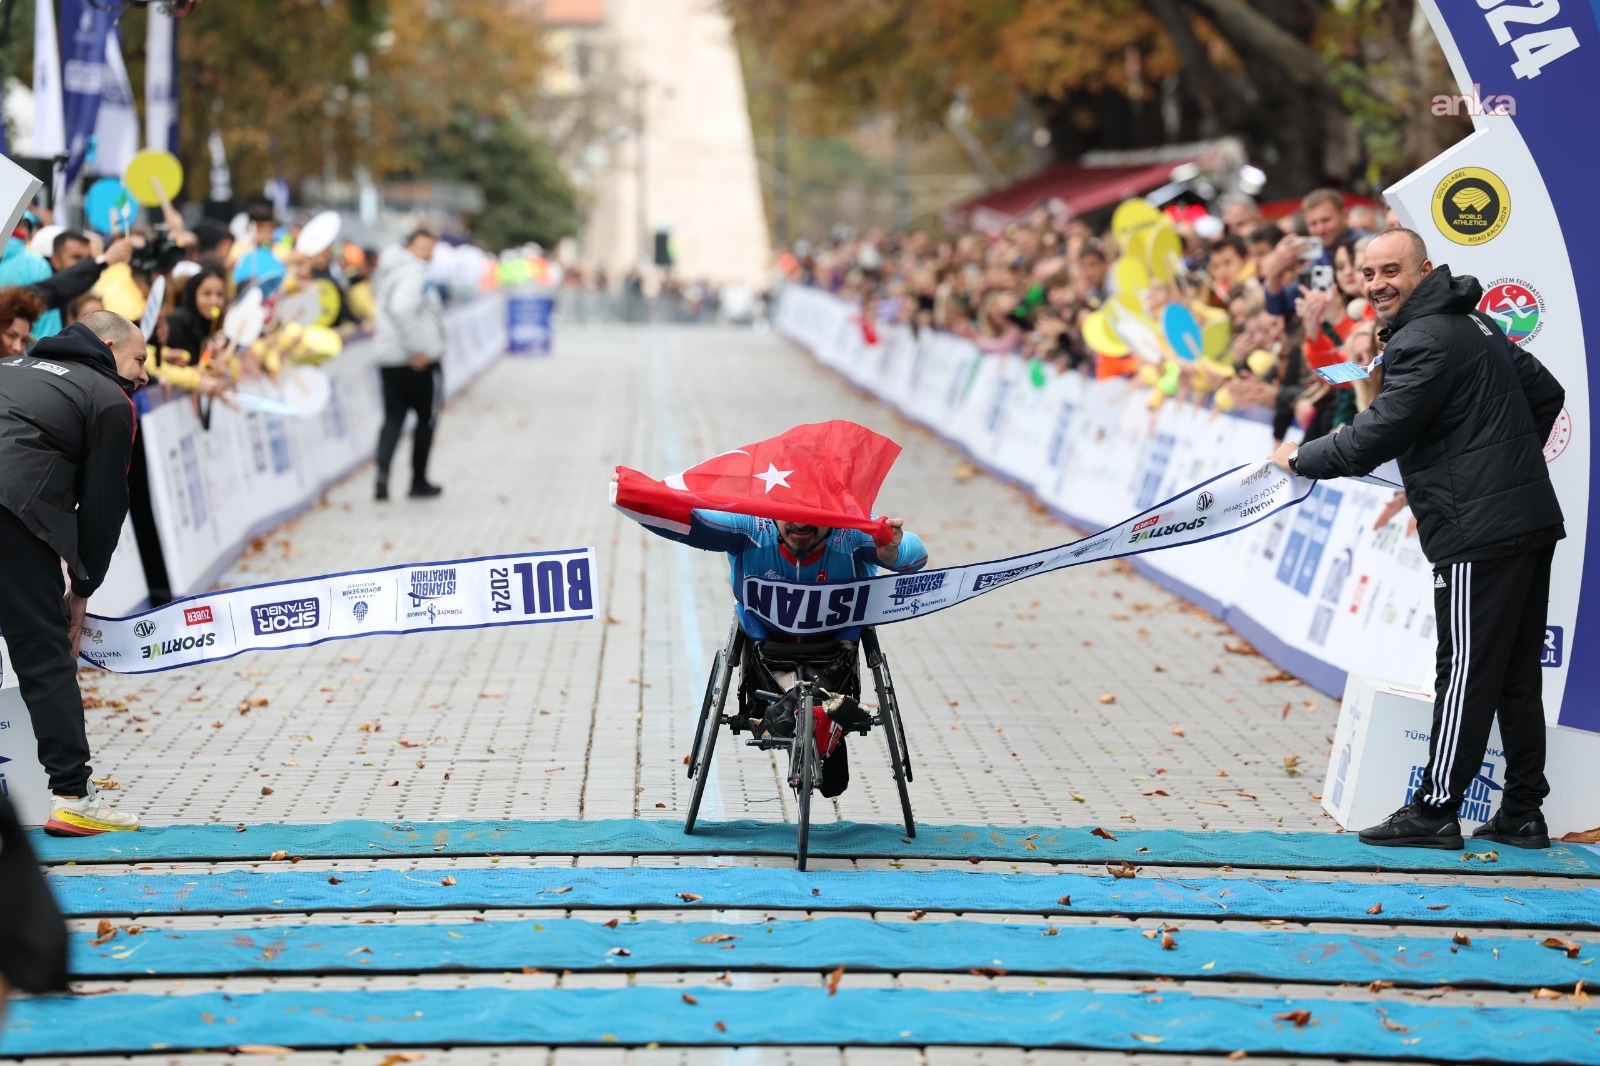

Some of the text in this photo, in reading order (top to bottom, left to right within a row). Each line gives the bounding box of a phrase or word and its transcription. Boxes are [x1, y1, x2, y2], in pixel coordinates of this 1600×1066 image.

[1476, 0, 1581, 80] 24
[1436, 171, 1467, 199] GOLD LABEL
[1468, 234, 1487, 243] ROAD
[1486, 223, 1501, 238] RACE
[1487, 276, 1547, 313] ATLETİZM FEDERASYONU
[1249, 494, 1259, 505] GT
[1259, 477, 1289, 499] WATCH
[1197, 492, 1214, 512] MG
[1240, 497, 1275, 518] HUAWEI
[1128, 516, 1208, 545] SPORTIVE
[410, 568, 457, 583] MARATHON
[513, 558, 593, 615] BUL
[894, 572, 947, 588] MARATONU
[490, 568, 512, 613] 2024
[746, 580, 871, 630] ISTAN
[256, 610, 317, 633] SPOR
[91, 651, 122, 659] WATCH
[140, 632, 216, 660] SPORTIVE
